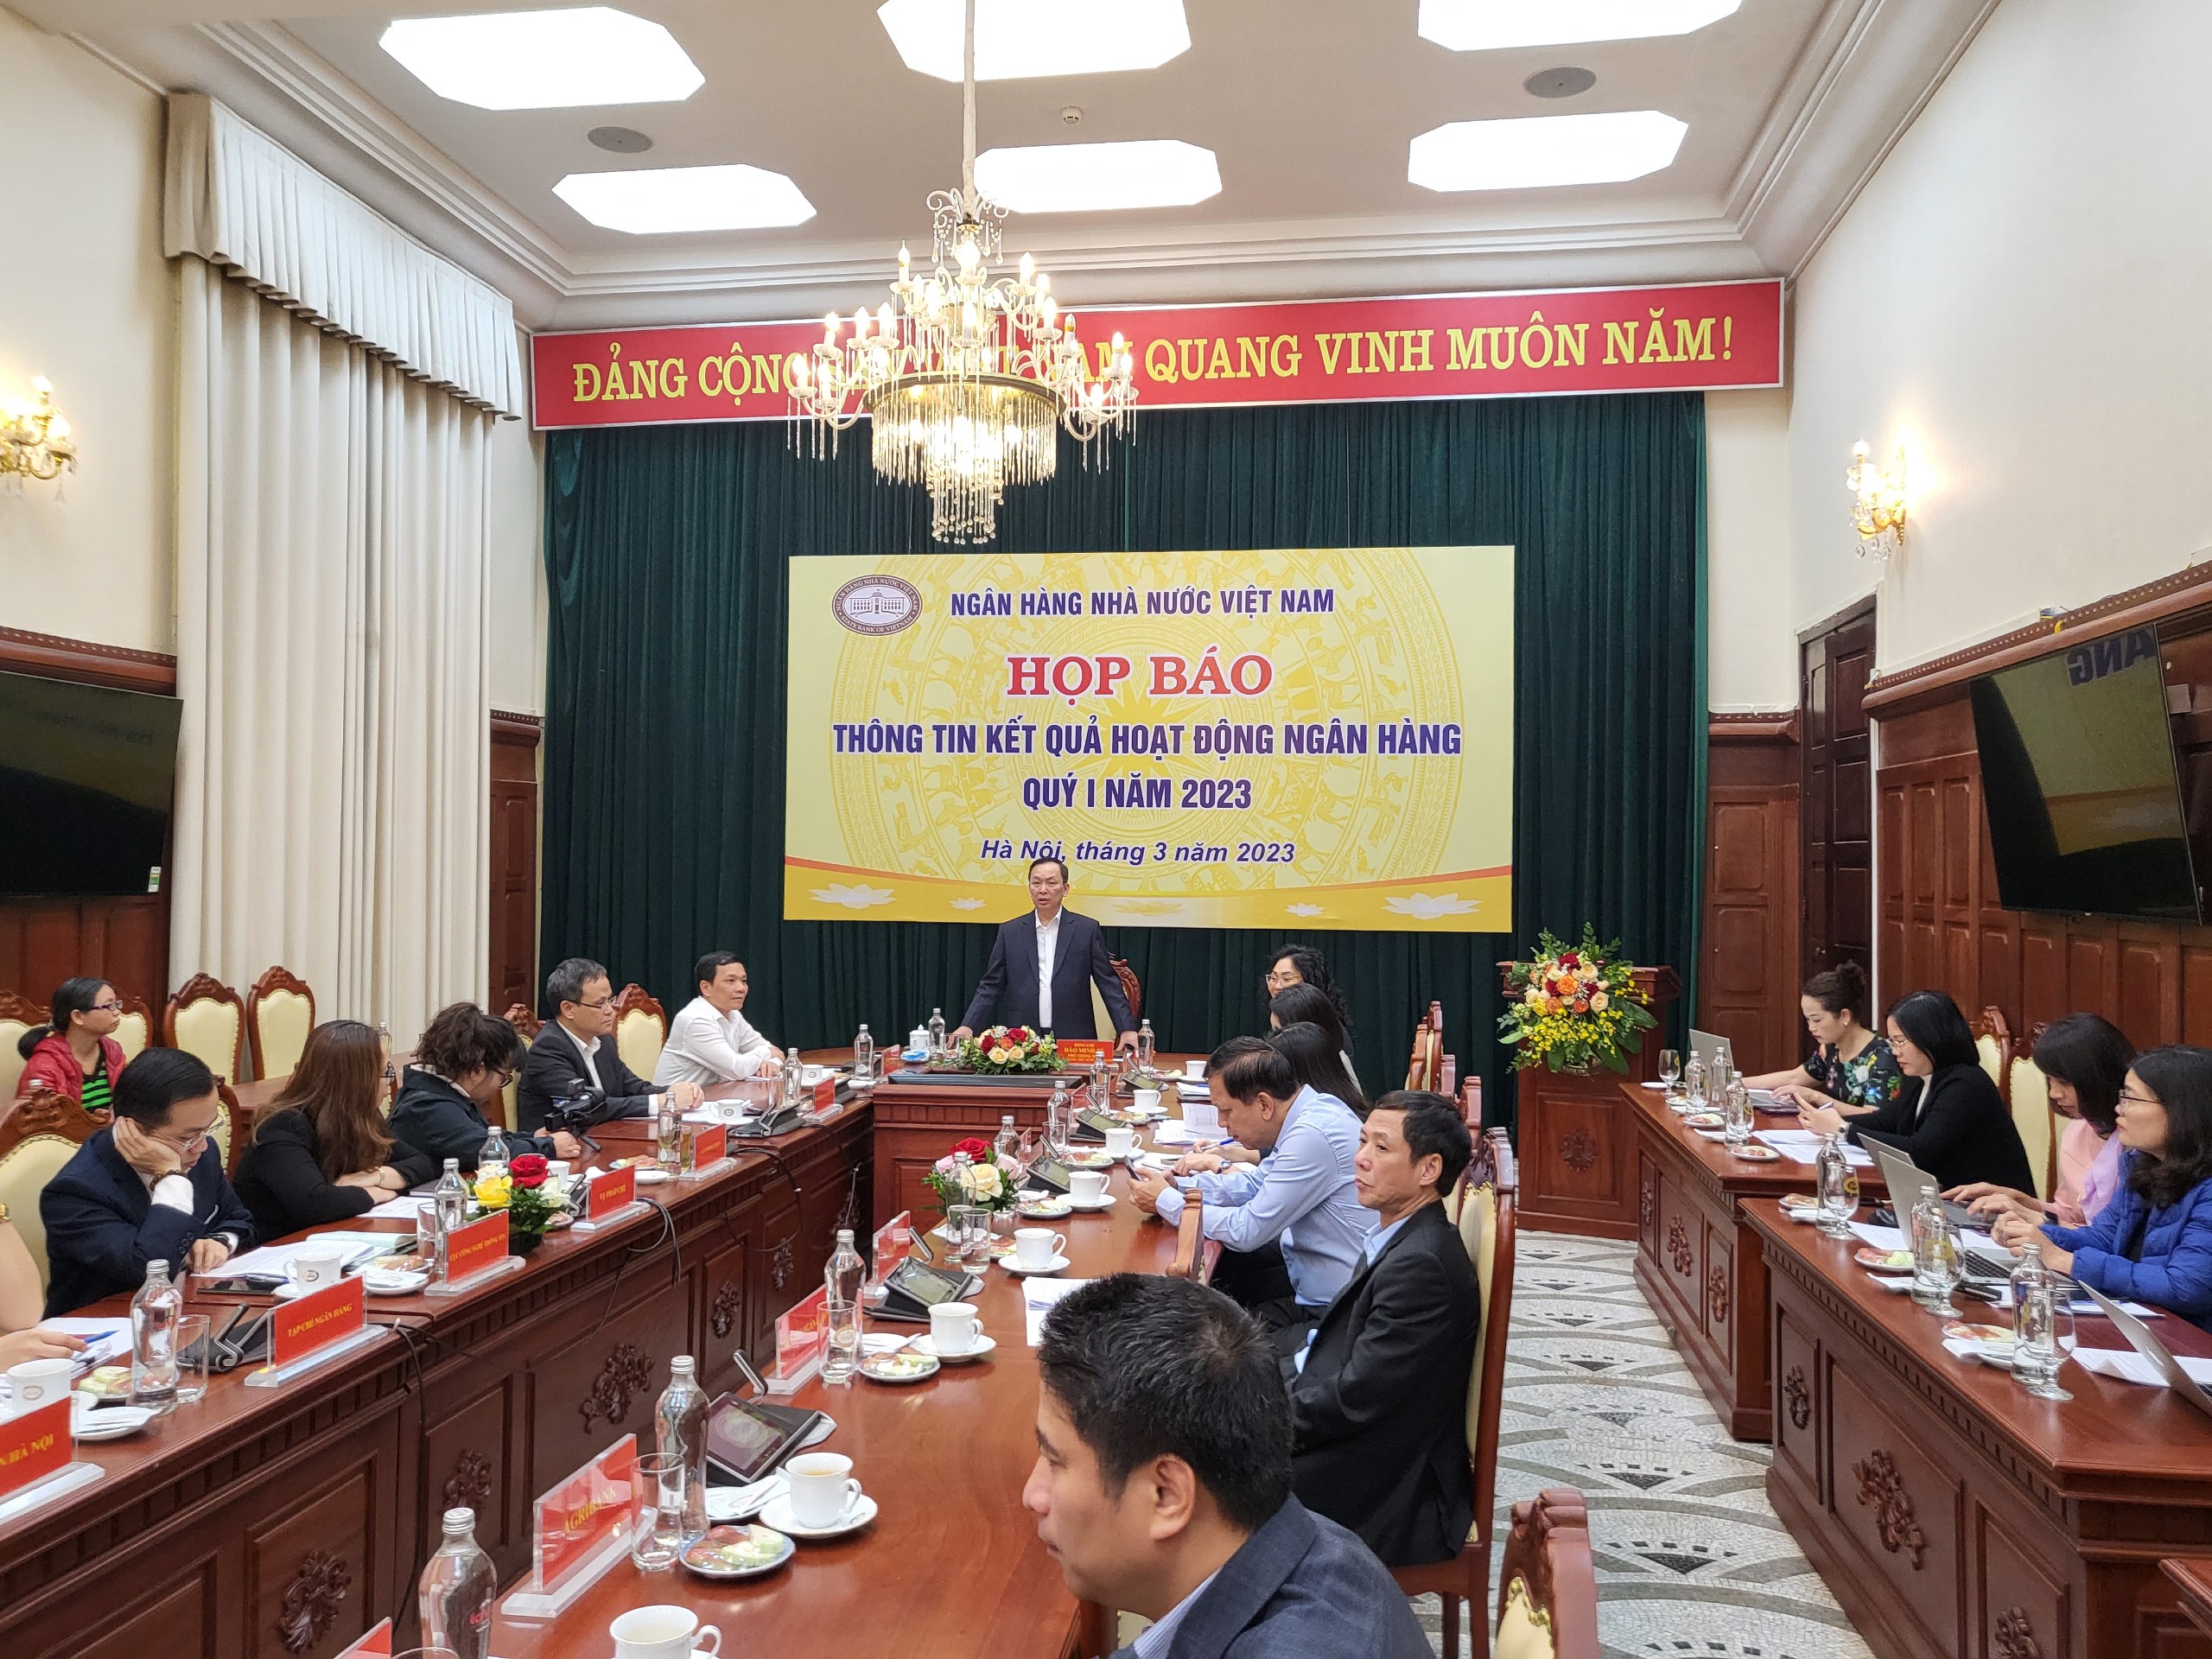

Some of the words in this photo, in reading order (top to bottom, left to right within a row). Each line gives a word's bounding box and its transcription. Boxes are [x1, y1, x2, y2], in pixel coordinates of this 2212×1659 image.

[572, 342, 689, 403] ĐẢNG
[1145, 334, 1302, 384] QUANG
[1316, 329, 1433, 375] VINH
[1446, 310, 1590, 371] MUÔN
[1603, 307, 1734, 365] NĂM!
[951, 588, 1012, 616] NGÂN
[1021, 588, 1083, 616] HÀNG
[1091, 586, 1139, 616] NHÀ
[1147, 585, 1211, 614] NƯỚC
[1220, 585, 1274, 619] VIỆT
[1281, 589, 1335, 613] NAM
[840, 615, 856, 628] STATE
[857, 624, 876, 632] BANK
[886, 615, 913, 631] VIETNAM
[1007, 656, 1131, 706] HỌP
[1149, 646, 1273, 696] BÁO
[833, 719, 923, 754] THÔNG
[932, 724, 977, 754] TIN
[986, 715, 1037, 754] KẾT
[1046, 715, 1103, 759] QUẢ
[1111, 725, 1185, 762] HOẠT
[1193, 719, 1274, 762] ĐỘNG
[1285, 719, 1369, 755] NGÂN
[1378, 717, 1462, 755] HÀNG
[1023, 772, 1078, 811] QUÝ
[1088, 779, 1096, 809] I
[1105, 772, 1173, 809] NĂM
[1181, 779, 1252, 810] 2023
[981, 840, 1013, 860] Hà
[1076, 841, 1147, 867] tháng
[1154, 842, 1167, 862] 3
[1175, 842, 1229, 863] năm
[1236, 843, 1297, 863] 2023
